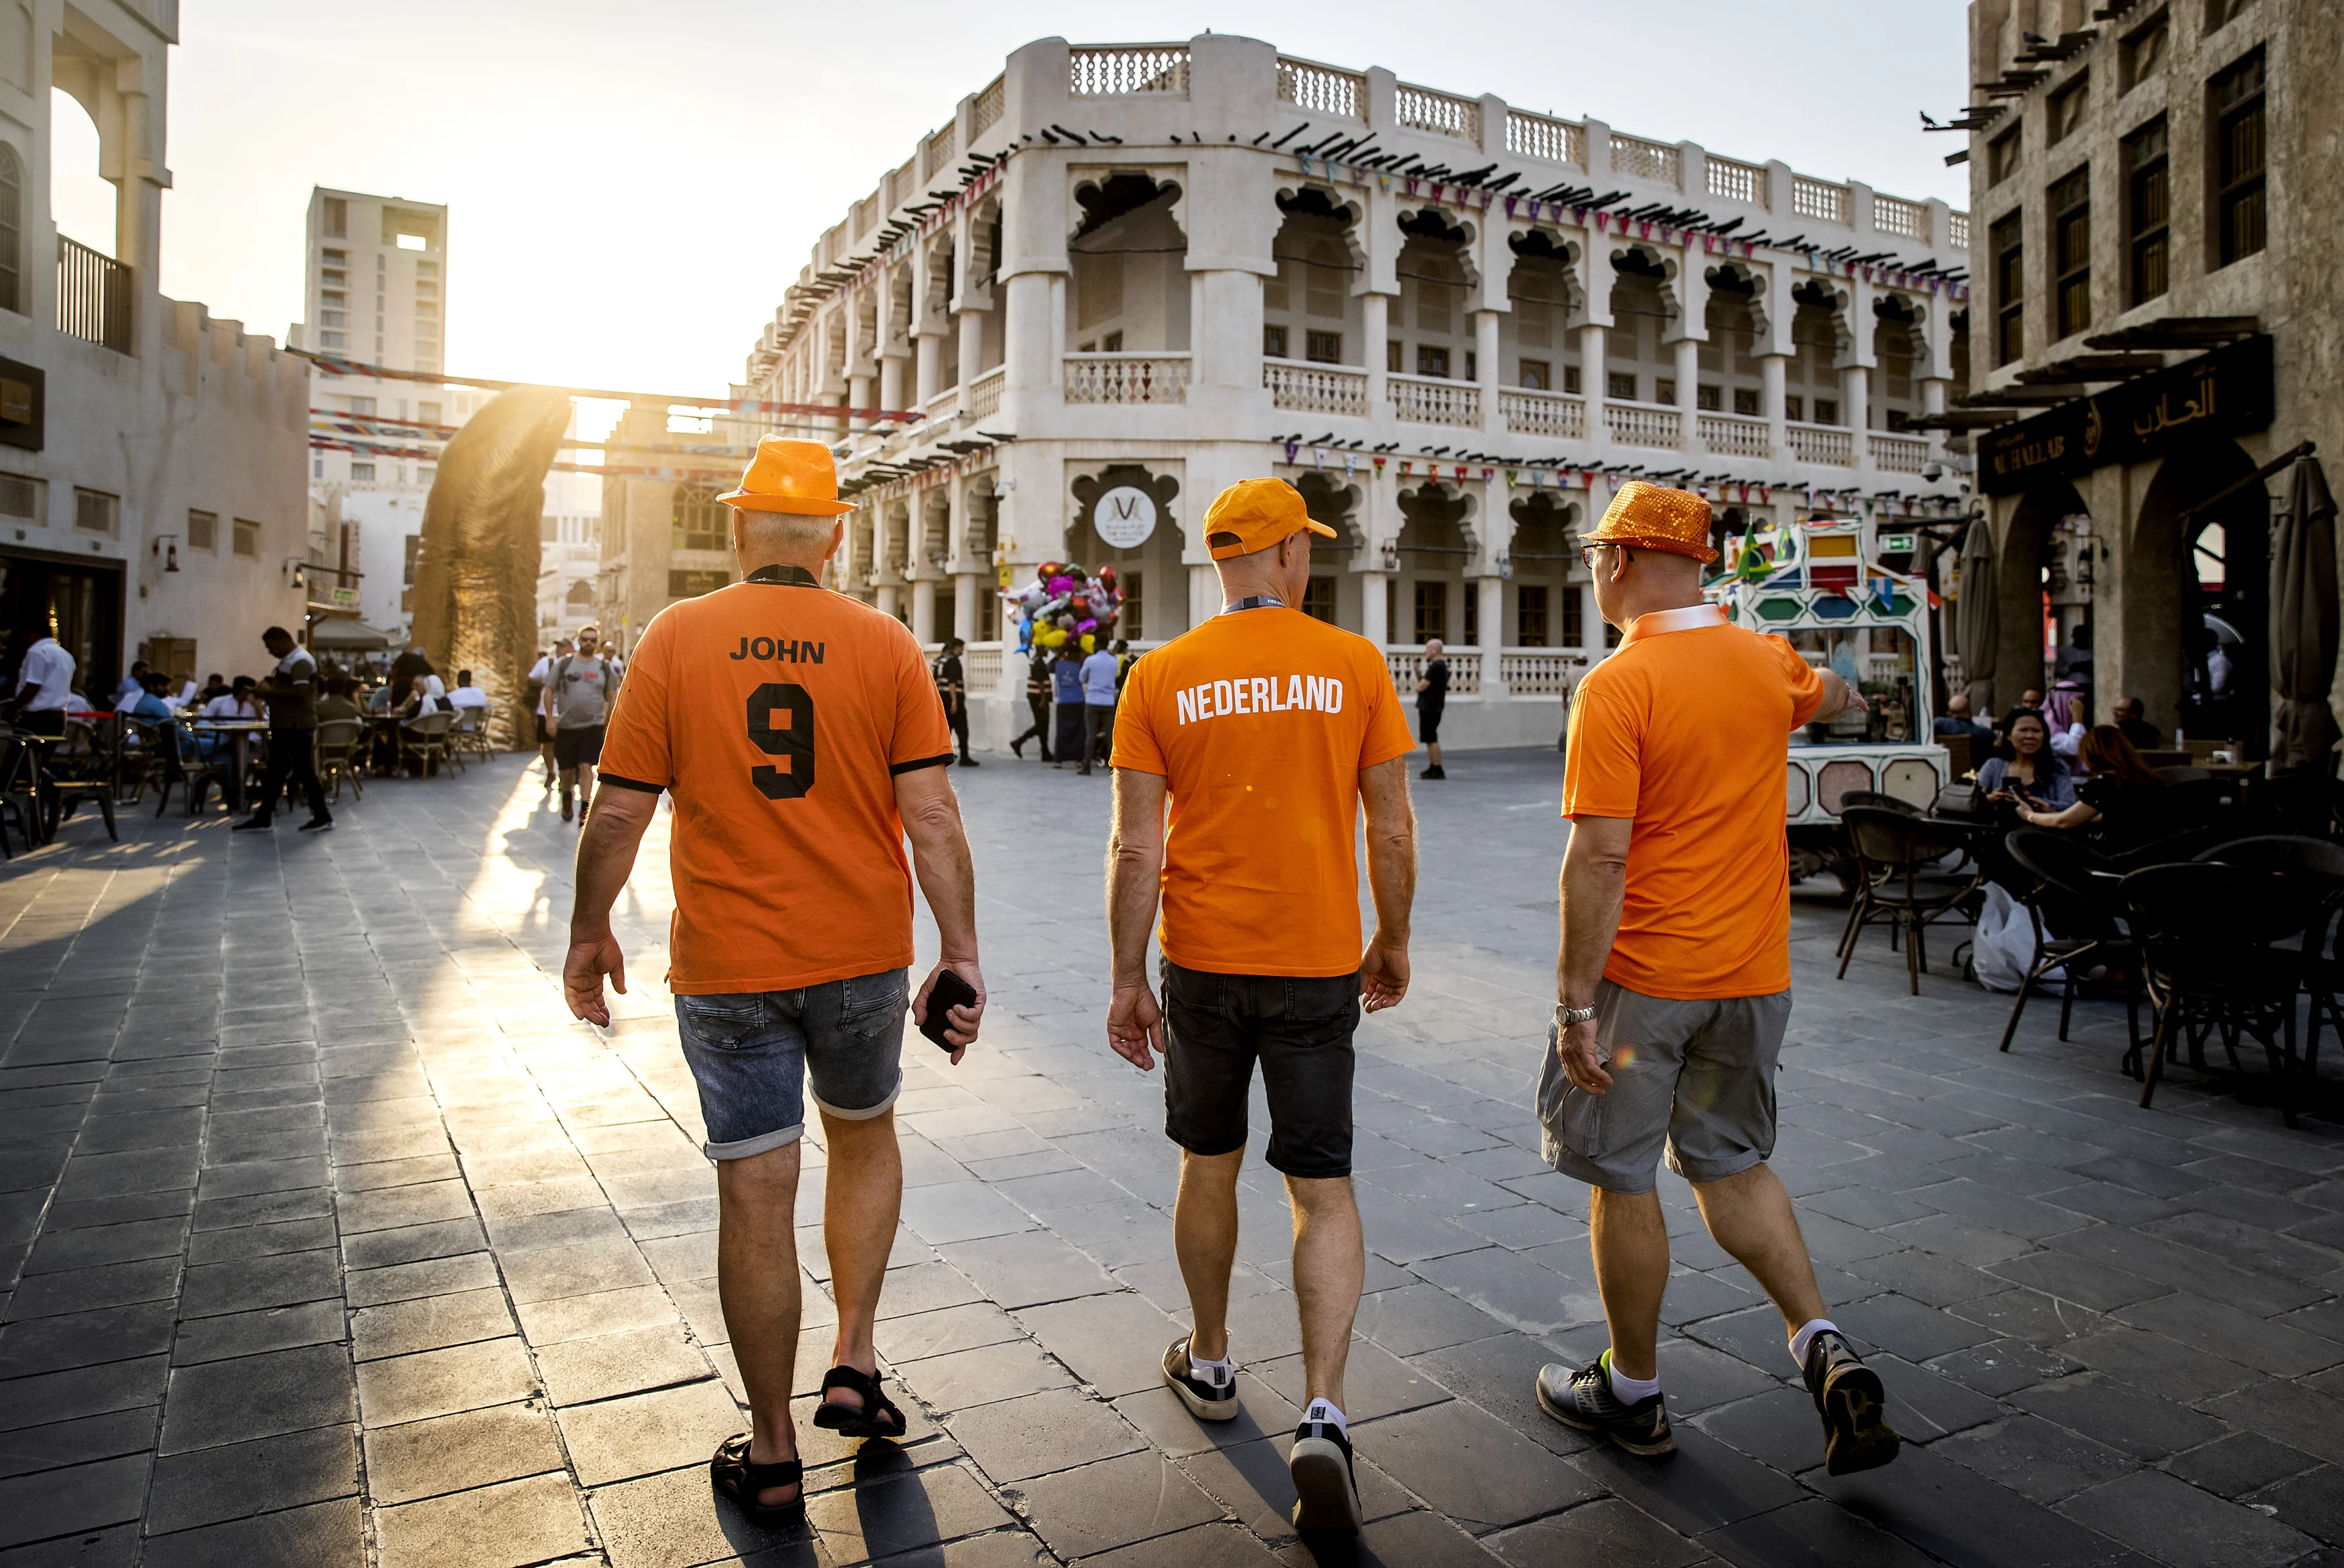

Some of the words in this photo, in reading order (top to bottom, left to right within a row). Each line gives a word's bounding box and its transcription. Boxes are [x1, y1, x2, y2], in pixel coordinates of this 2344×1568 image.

[2011, 436, 2064, 471] HALLAB
[729, 637, 825, 664] JOHN
[1176, 674, 1343, 725] NEDERLAND
[747, 683, 815, 800] 9
